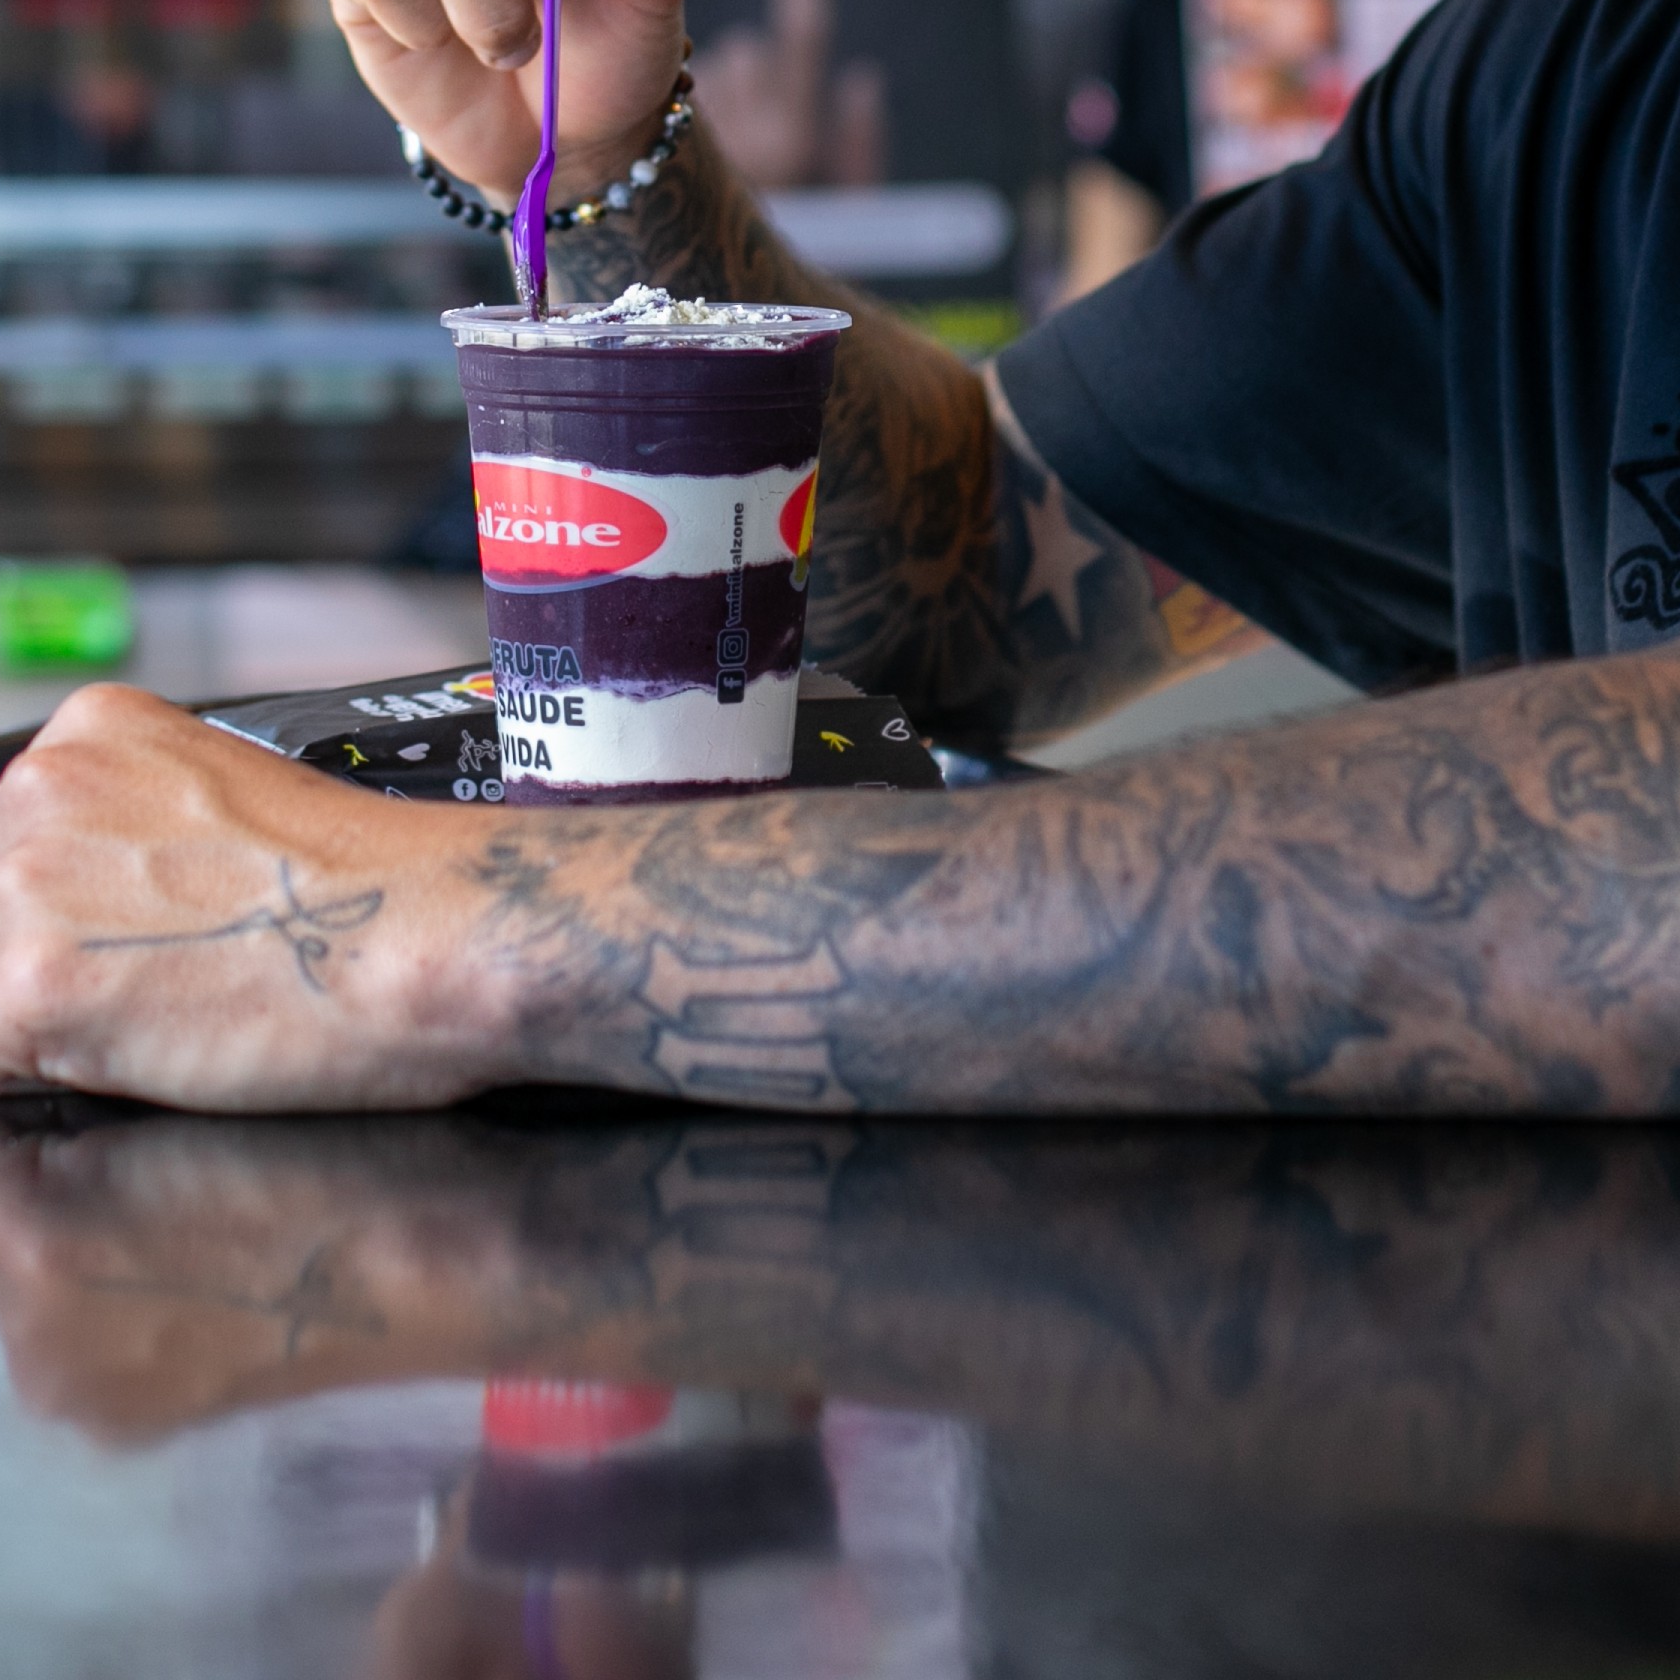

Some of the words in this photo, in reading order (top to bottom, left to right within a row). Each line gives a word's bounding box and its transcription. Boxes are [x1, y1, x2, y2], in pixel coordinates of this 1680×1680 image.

[477, 506, 622, 548] alzone
[493, 501, 553, 516] MINI
[492, 638, 582, 682] FRUTA
[497, 682, 586, 726] SAÚDE
[502, 733, 552, 772] VIDA
